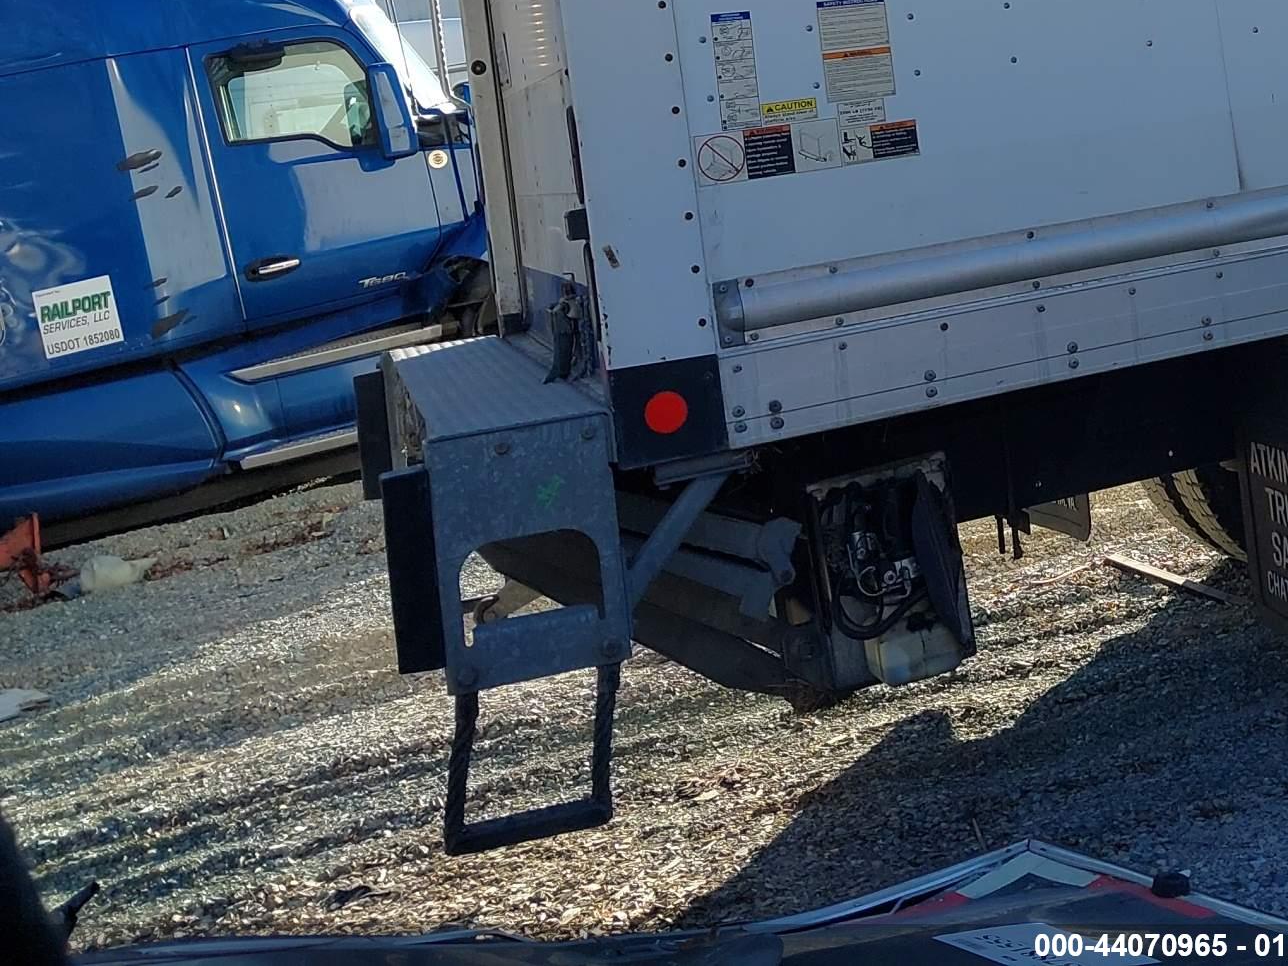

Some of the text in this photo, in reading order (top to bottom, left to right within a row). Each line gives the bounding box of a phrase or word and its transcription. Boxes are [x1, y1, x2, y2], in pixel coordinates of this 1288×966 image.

[774, 100, 813, 111] CAUTION
[40, 291, 111, 323] RAILPORT
[43, 310, 110, 335] SERVICES, LLC
[47, 328, 121, 355] USDOT 1852080
